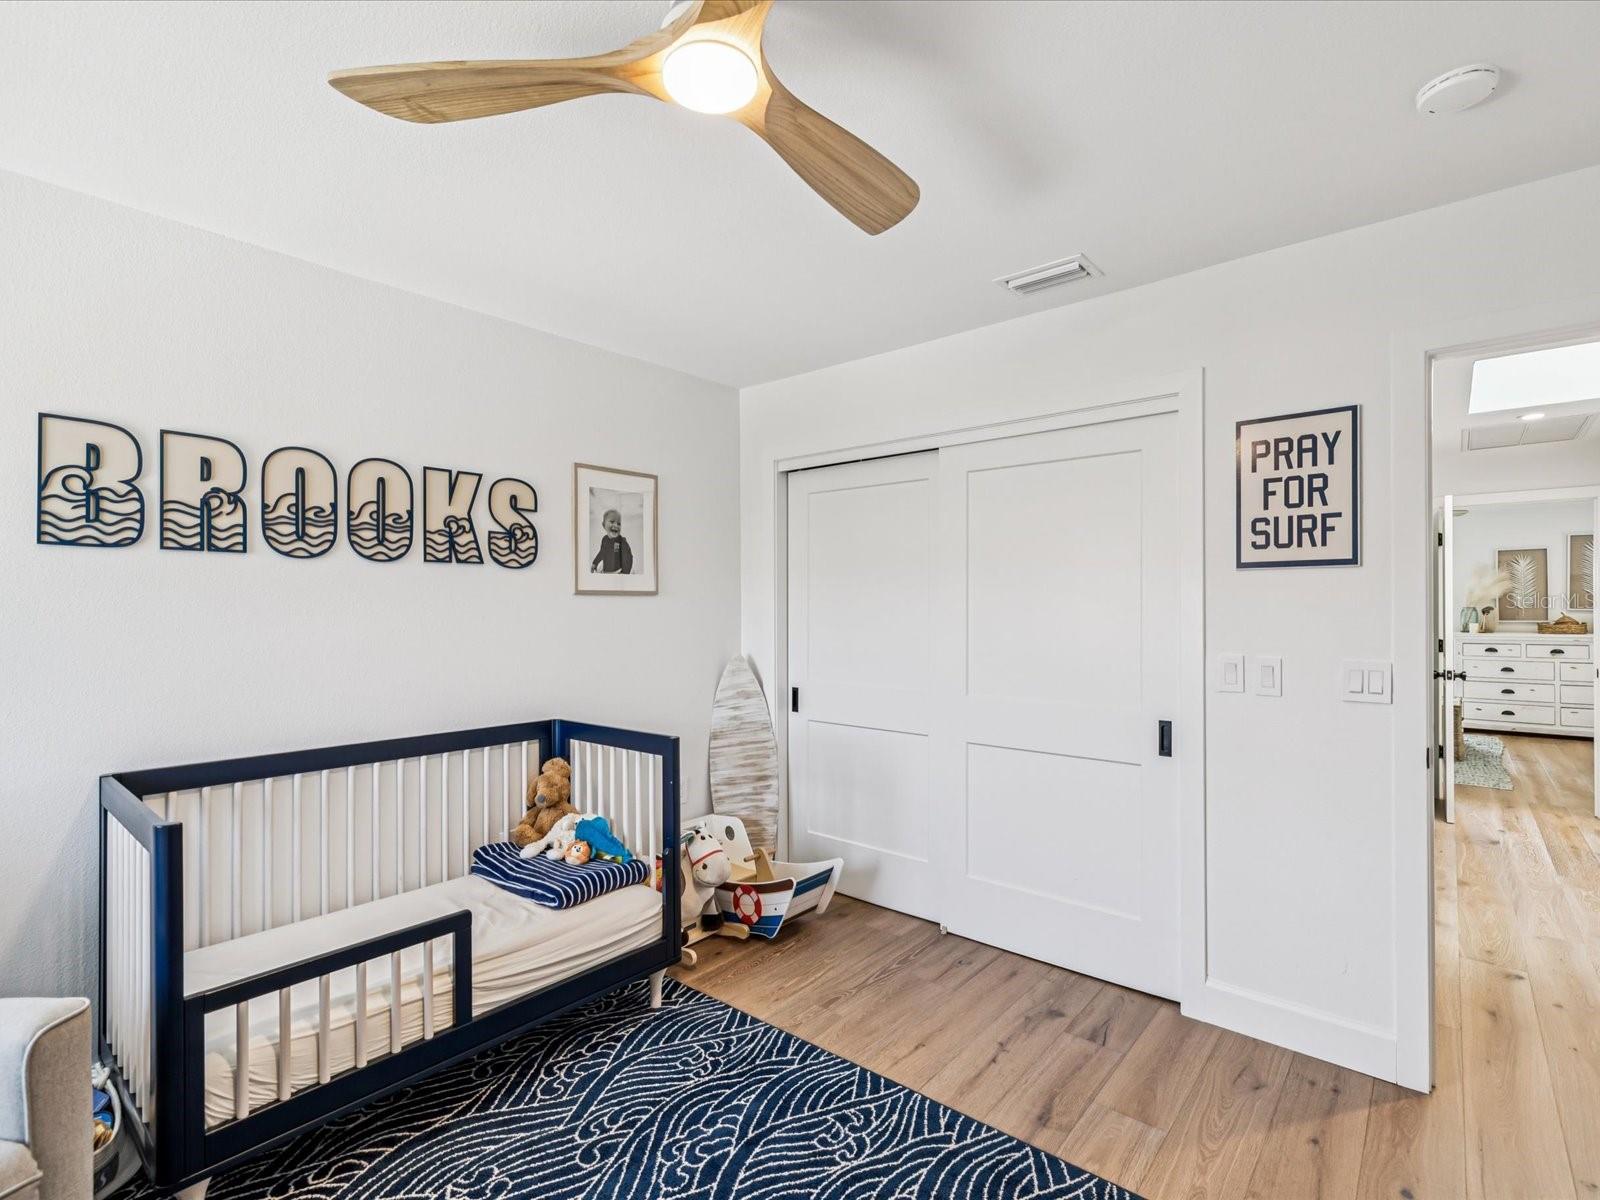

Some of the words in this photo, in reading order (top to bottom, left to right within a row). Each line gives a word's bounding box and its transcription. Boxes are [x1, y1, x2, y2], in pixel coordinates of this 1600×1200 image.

[1250, 431, 1342, 473] PRAY
[37, 412, 538, 569] BROOKS
[1263, 473, 1329, 511] FOR
[1250, 512, 1343, 550] SURF
